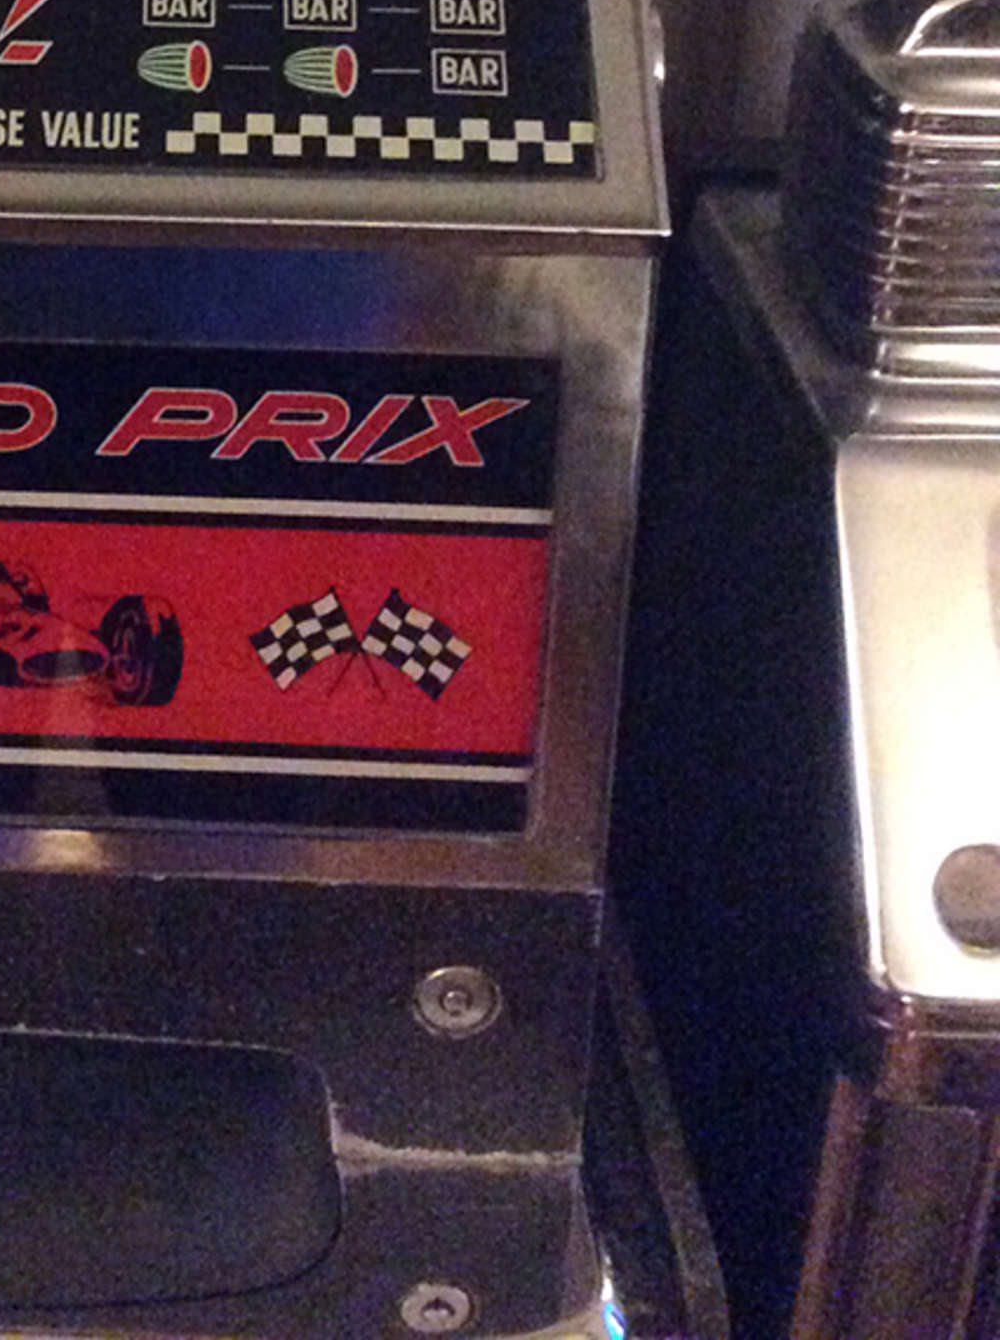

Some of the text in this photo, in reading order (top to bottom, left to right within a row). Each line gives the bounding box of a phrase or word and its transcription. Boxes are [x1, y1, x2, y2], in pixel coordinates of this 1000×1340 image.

[440, 56, 500, 87] BAR
[41, 110, 140, 151] VALUE
[95, 388, 532, 468] PRIX
